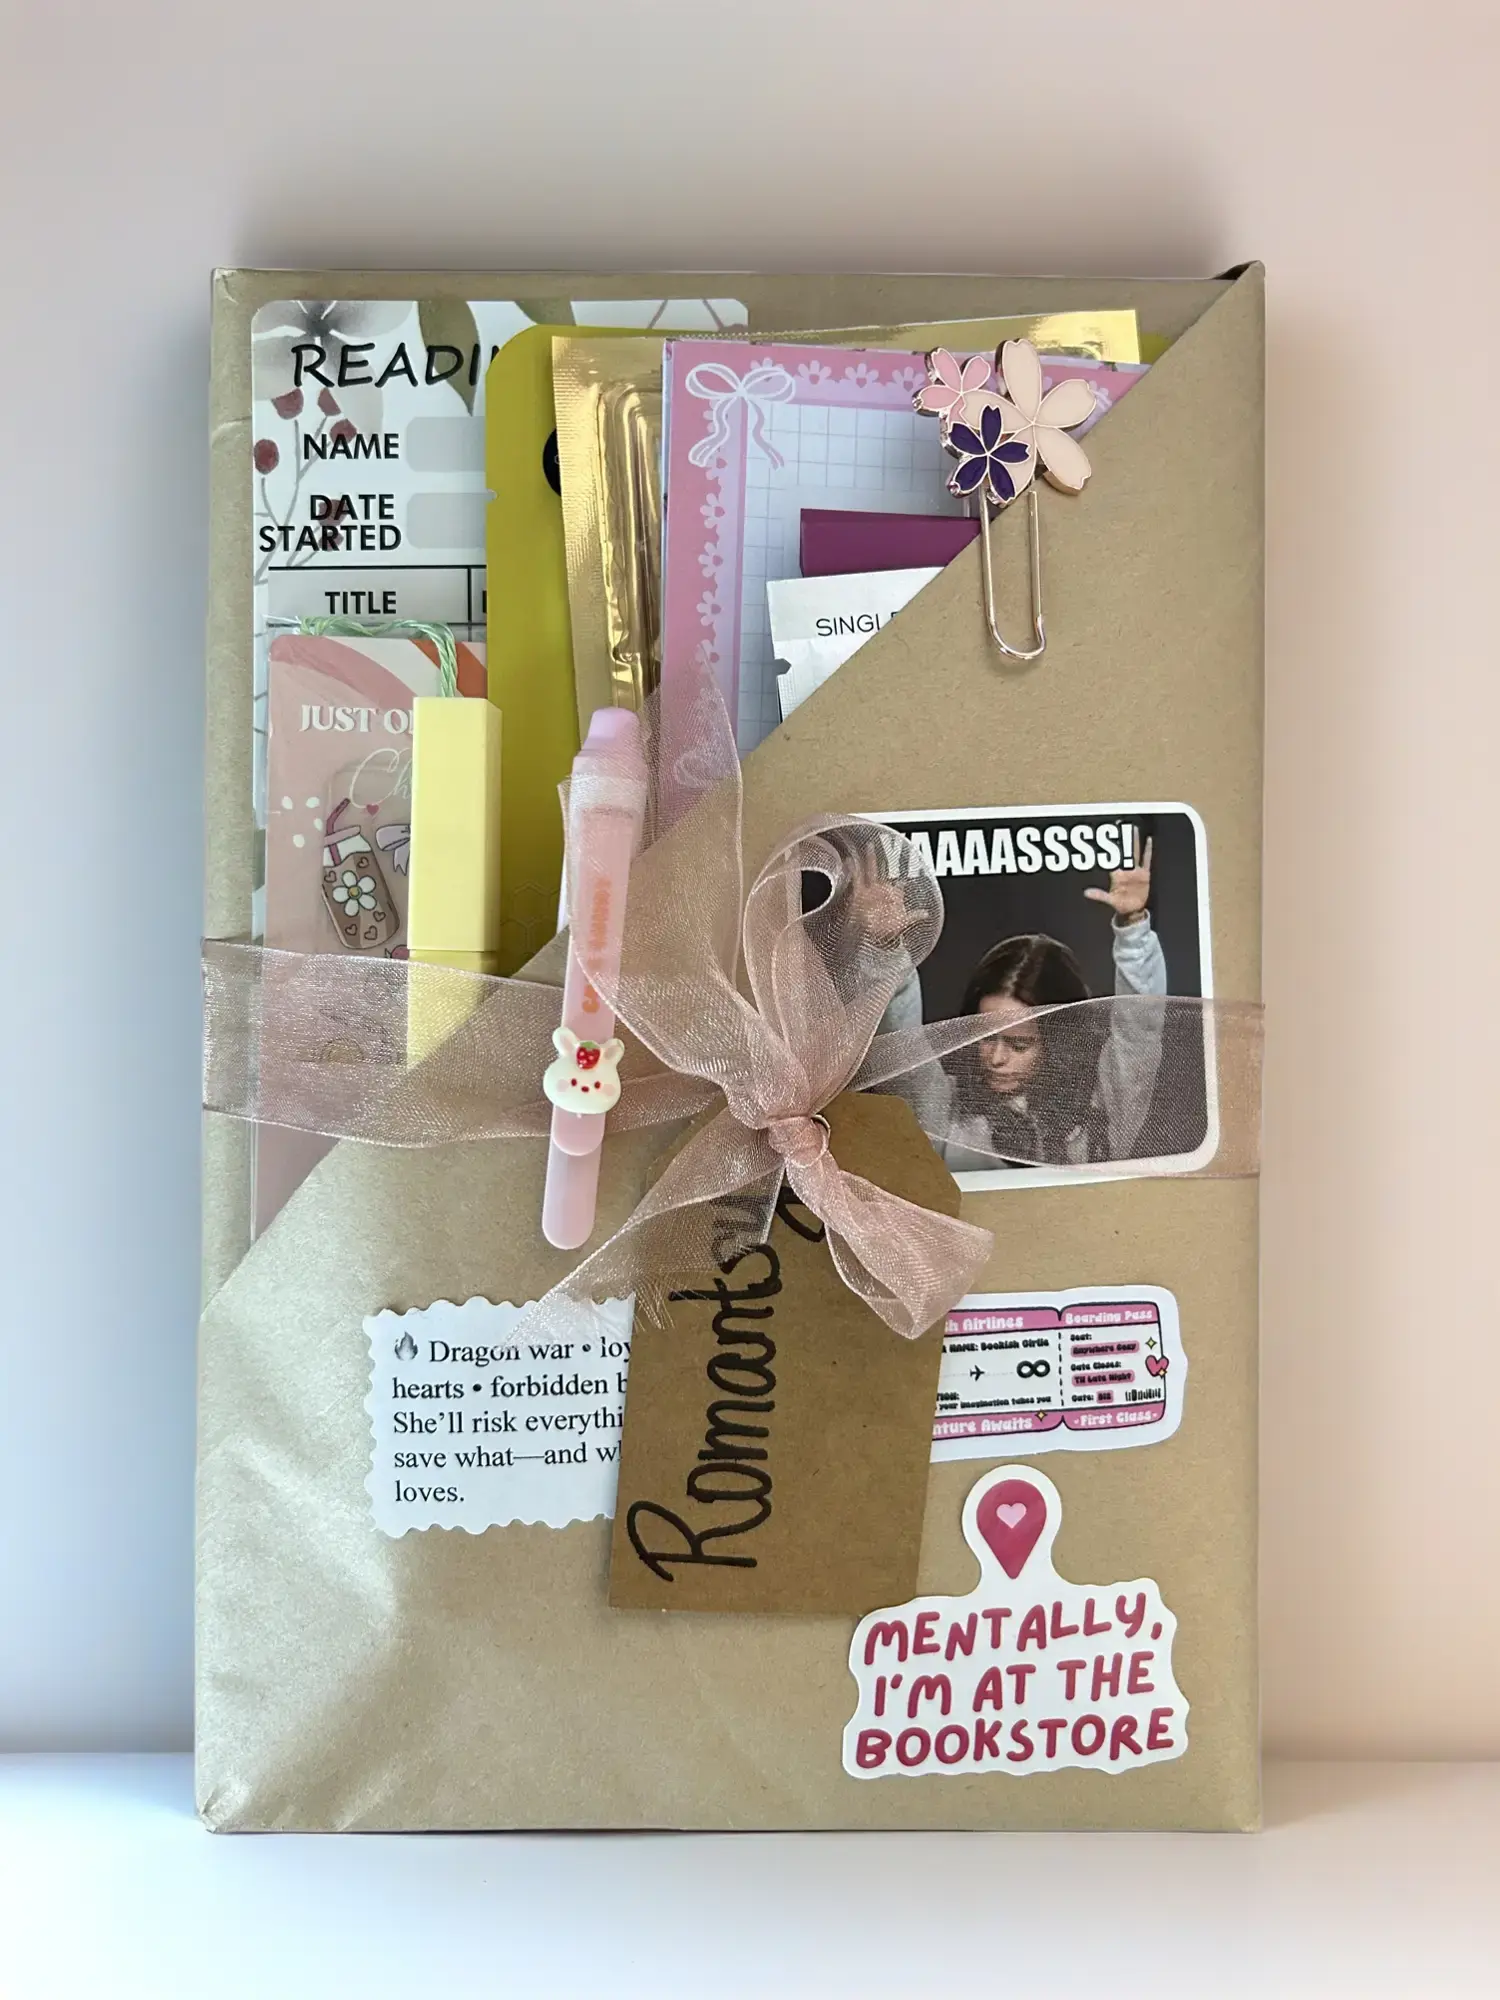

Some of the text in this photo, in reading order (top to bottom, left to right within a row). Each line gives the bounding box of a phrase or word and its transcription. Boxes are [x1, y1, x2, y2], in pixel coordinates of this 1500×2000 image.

[303, 434, 399, 460] NAME
[310, 494, 395, 521] DATE
[259, 525, 401, 552] STARTED
[325, 591, 397, 614] TITLE
[816, 611, 898, 637] SINGL
[299, 704, 378, 732] JUST
[880, 823, 1134, 878] YAAAASSSS!
[963, 1316, 1024, 1332] Airlines
[1065, 1309, 1153, 1325] Boarding Pass
[949, 1342, 978, 1354] NAME:
[981, 1339, 1019, 1351] Bookish
[1022, 1338, 1049, 1348] Girlie
[1070, 1332, 1092, 1341] Seat:
[429, 1340, 521, 1367] Dragon
[529, 1342, 575, 1361] war
[1073, 1345, 1114, 1355] Anywhere
[1071, 1361, 1121, 1372] Gate Closes:
[1088, 1374, 1107, 1383] Late
[1109, 1372, 1132, 1382] Night
[392, 1376, 464, 1399] hearts
[490, 1373, 608, 1398] forbidden
[960, 1399, 1009, 1410] imagination
[1012, 1397, 1034, 1406] takes
[1036, 1396, 1051, 1404] you
[1072, 1394, 1094, 1402] Gate:
[394, 1406, 623, 1435] She’ll risk everythi
[982, 1416, 1032, 1432] Awaits
[394, 1450, 447, 1468] save
[395, 1480, 465, 1502] loves.
[864, 1592, 1162, 1666] MENTALLY,
[875, 1650, 1155, 1718] I'M AT THE
[856, 1707, 1175, 1769] BOOKSTORE
